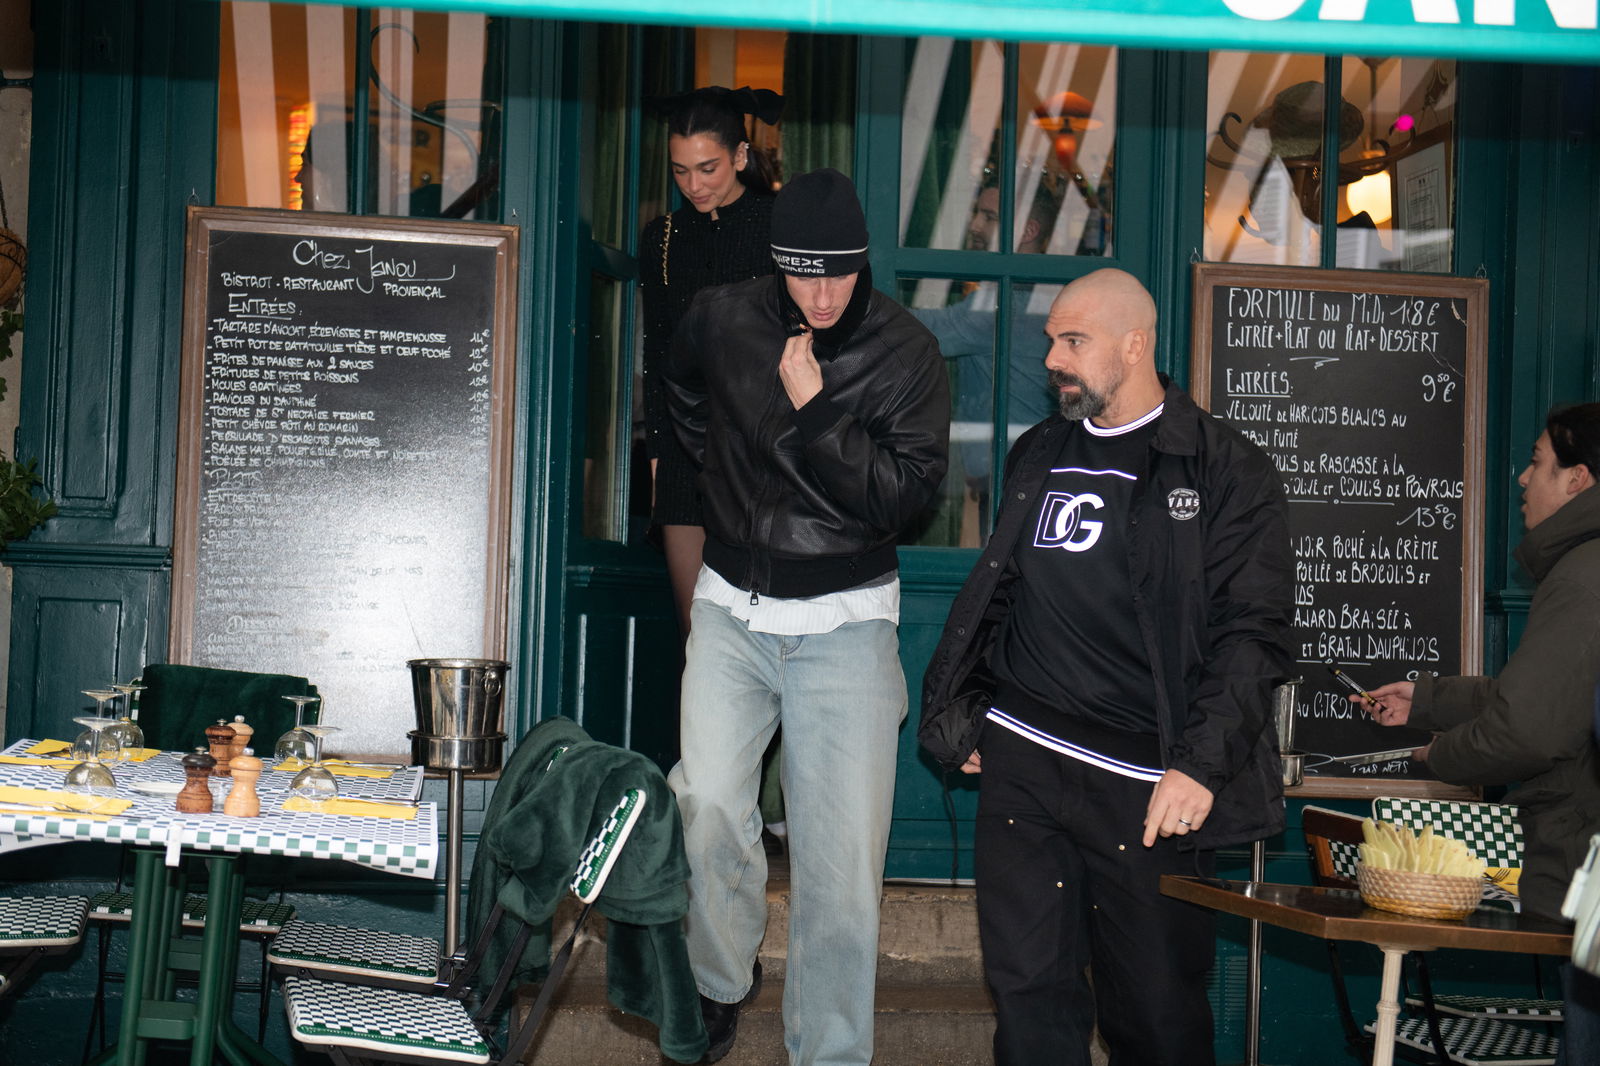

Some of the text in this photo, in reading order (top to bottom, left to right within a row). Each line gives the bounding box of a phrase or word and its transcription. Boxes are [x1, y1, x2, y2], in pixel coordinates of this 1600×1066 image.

[292, 239, 350, 269] Chez
[283, 277, 354, 292] RESTAURANT
[1228, 287, 1316, 321] FORMULE
[1323, 302, 1340, 322] DU
[213, 318, 262, 334] TARTARE
[363, 329, 378, 340] ET
[380, 331, 447, 343] PAMPLEMOUSSE
[247, 338, 268, 350] POT
[269, 341, 283, 350] DE
[380, 345, 394, 355] ET
[1318, 329, 1336, 350] OU
[252, 355, 265, 366] DE
[327, 356, 336, 370] 2
[339, 360, 374, 370] SAUCES
[262, 369, 276, 380] DE
[211, 378, 246, 390] MOULES
[260, 395, 271, 406] DU
[209, 405, 251, 417] TOSTADE
[255, 408, 268, 418] DE
[1226, 400, 1272, 422] VELOUTÉ
[1391, 413, 1407, 428] AU
[303, 421, 315, 432] AU
[211, 442, 248, 455] SALADE
[1319, 453, 1378, 475] RASCASSE
[1168, 497, 1200, 508] VANS
[1396, 534, 1439, 560] CRÈME
[1418, 573, 1431, 585] ET
[1291, 607, 1336, 629] ANARD
